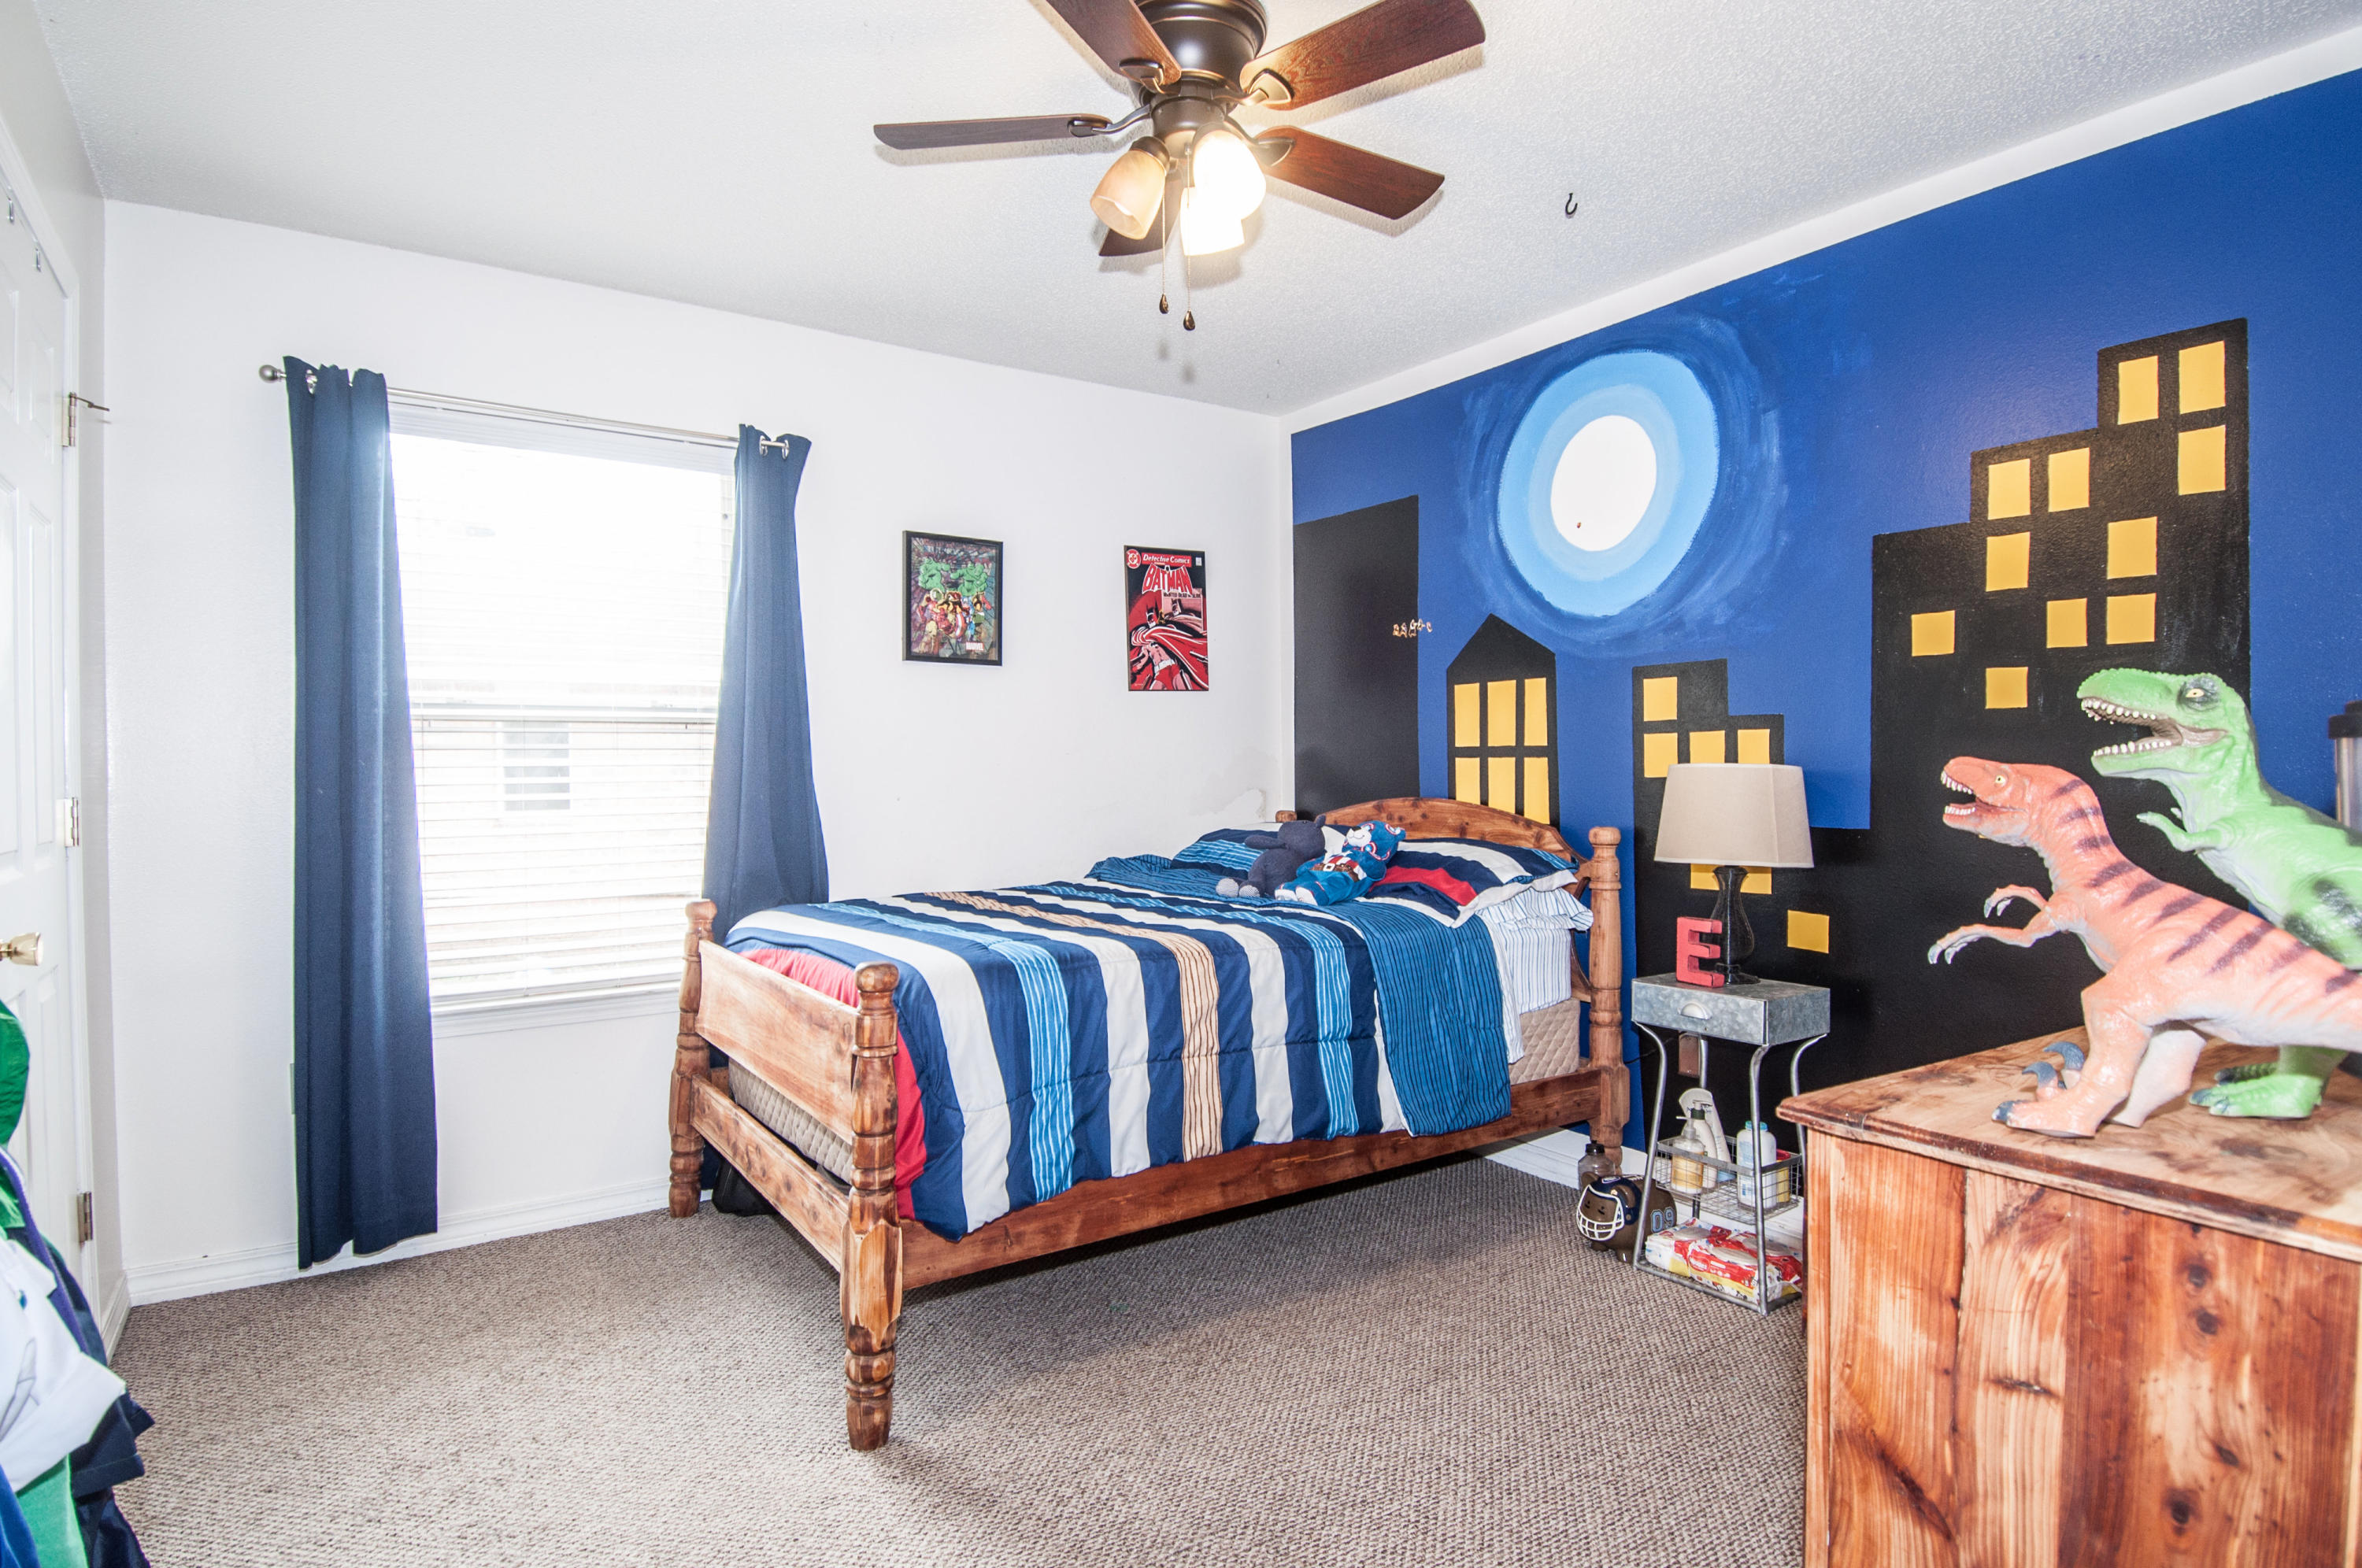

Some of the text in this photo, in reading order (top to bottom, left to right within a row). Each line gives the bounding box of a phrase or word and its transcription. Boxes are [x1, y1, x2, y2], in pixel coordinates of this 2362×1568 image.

[1142, 553, 1169, 563] Detective
[1170, 556, 1190, 564] Comics
[1142, 564, 1193, 594] BATMAN
[1675, 916, 1725, 988] E
[1650, 1206, 1675, 1233] 09
